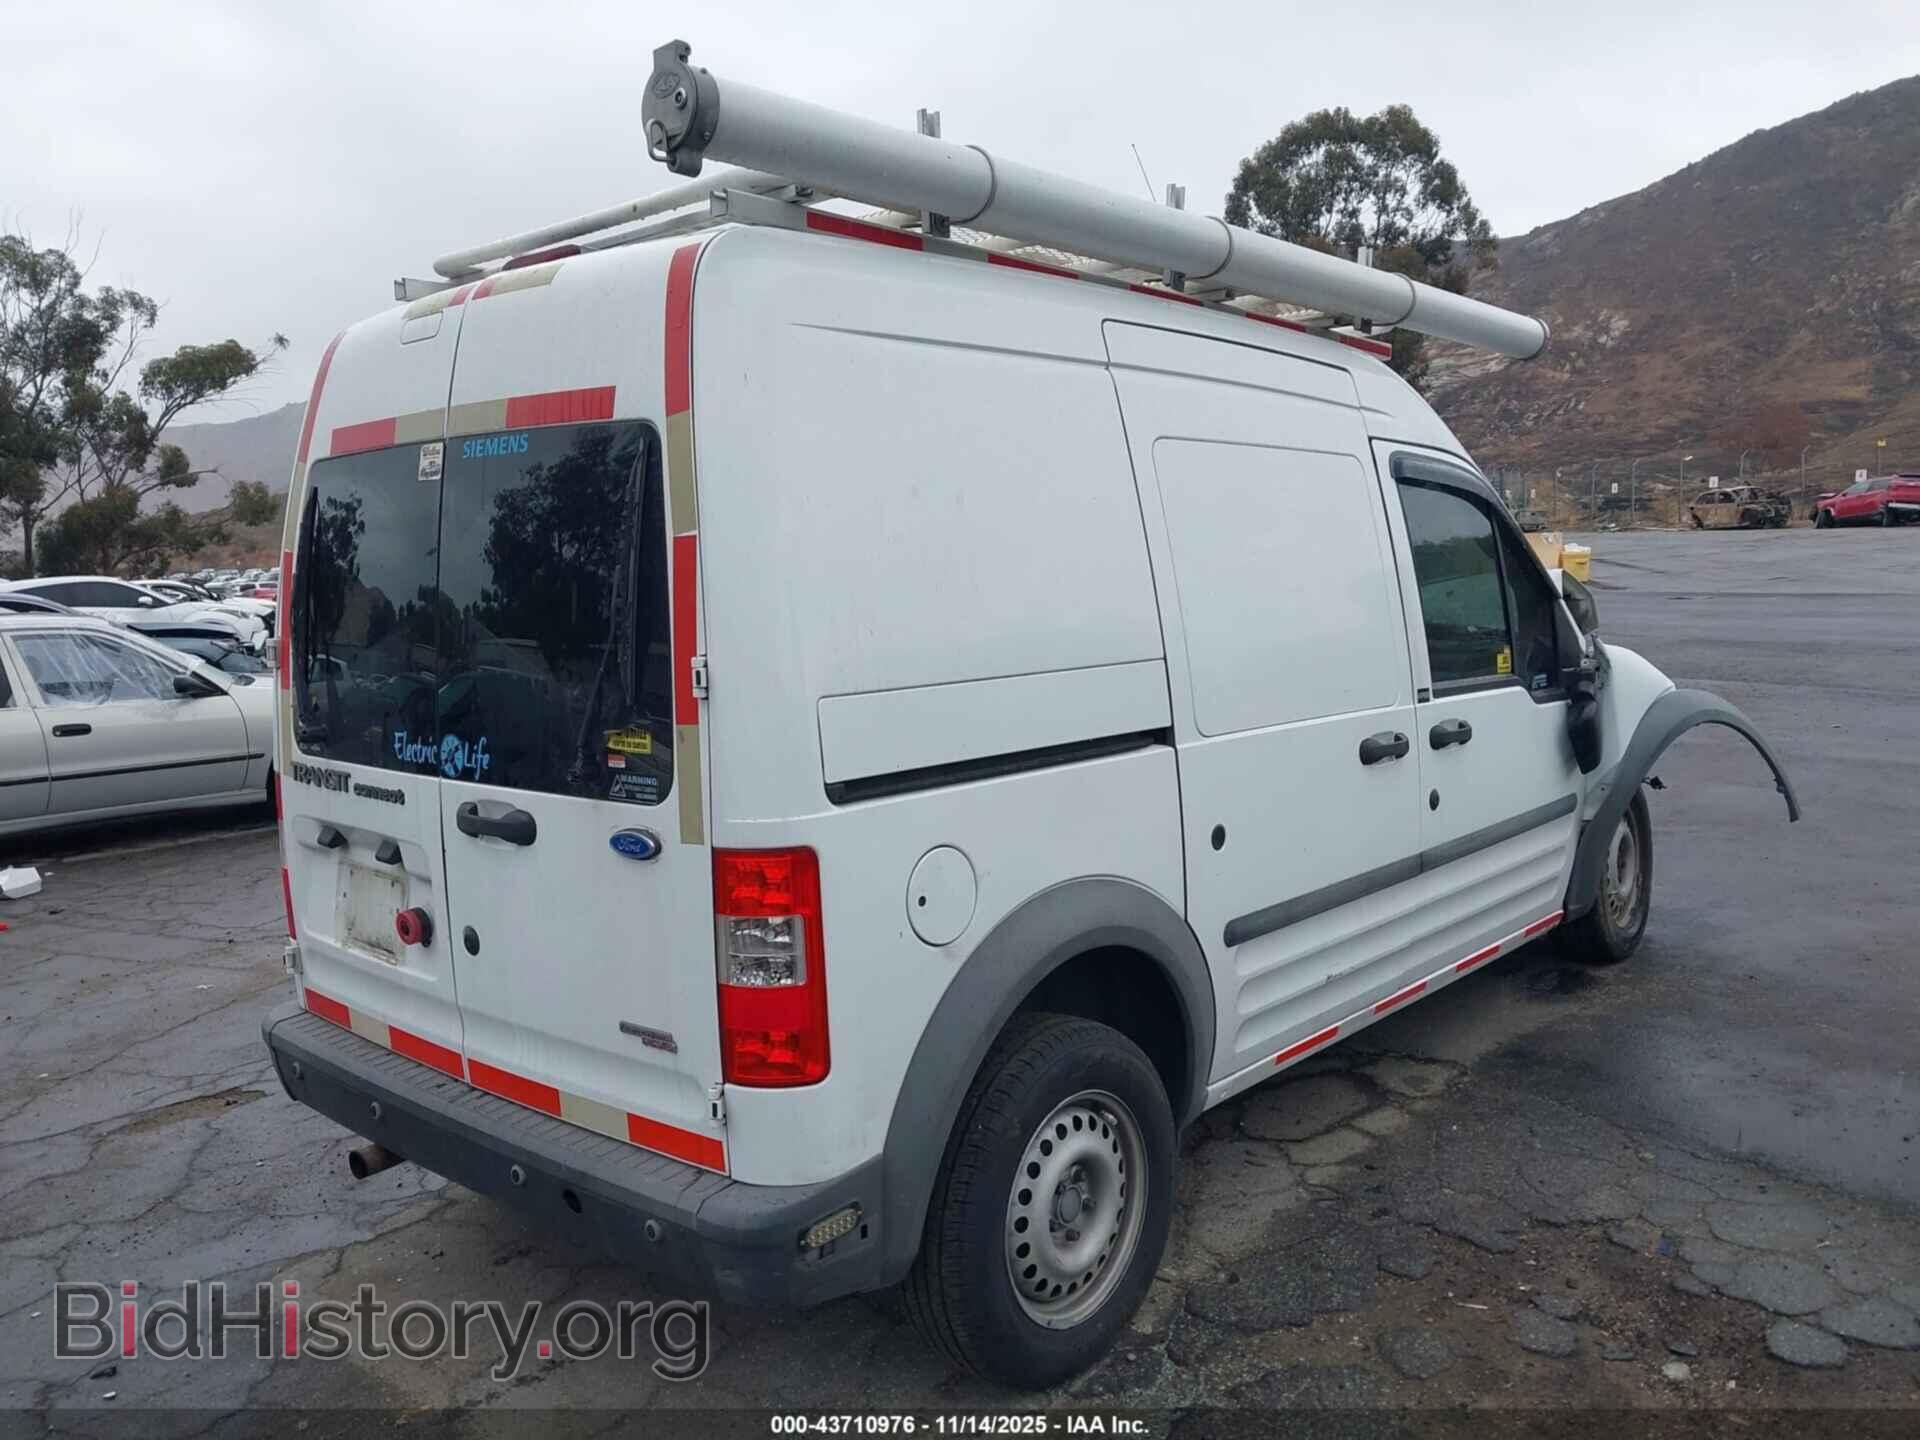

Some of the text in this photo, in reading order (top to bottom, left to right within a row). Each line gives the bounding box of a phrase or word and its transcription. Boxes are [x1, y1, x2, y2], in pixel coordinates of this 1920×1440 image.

[462, 432, 528, 459] SIEMENS
[394, 731, 490, 781] Electric Life
[290, 761, 351, 793] TRANSIT
[615, 836, 642, 854] Ford
